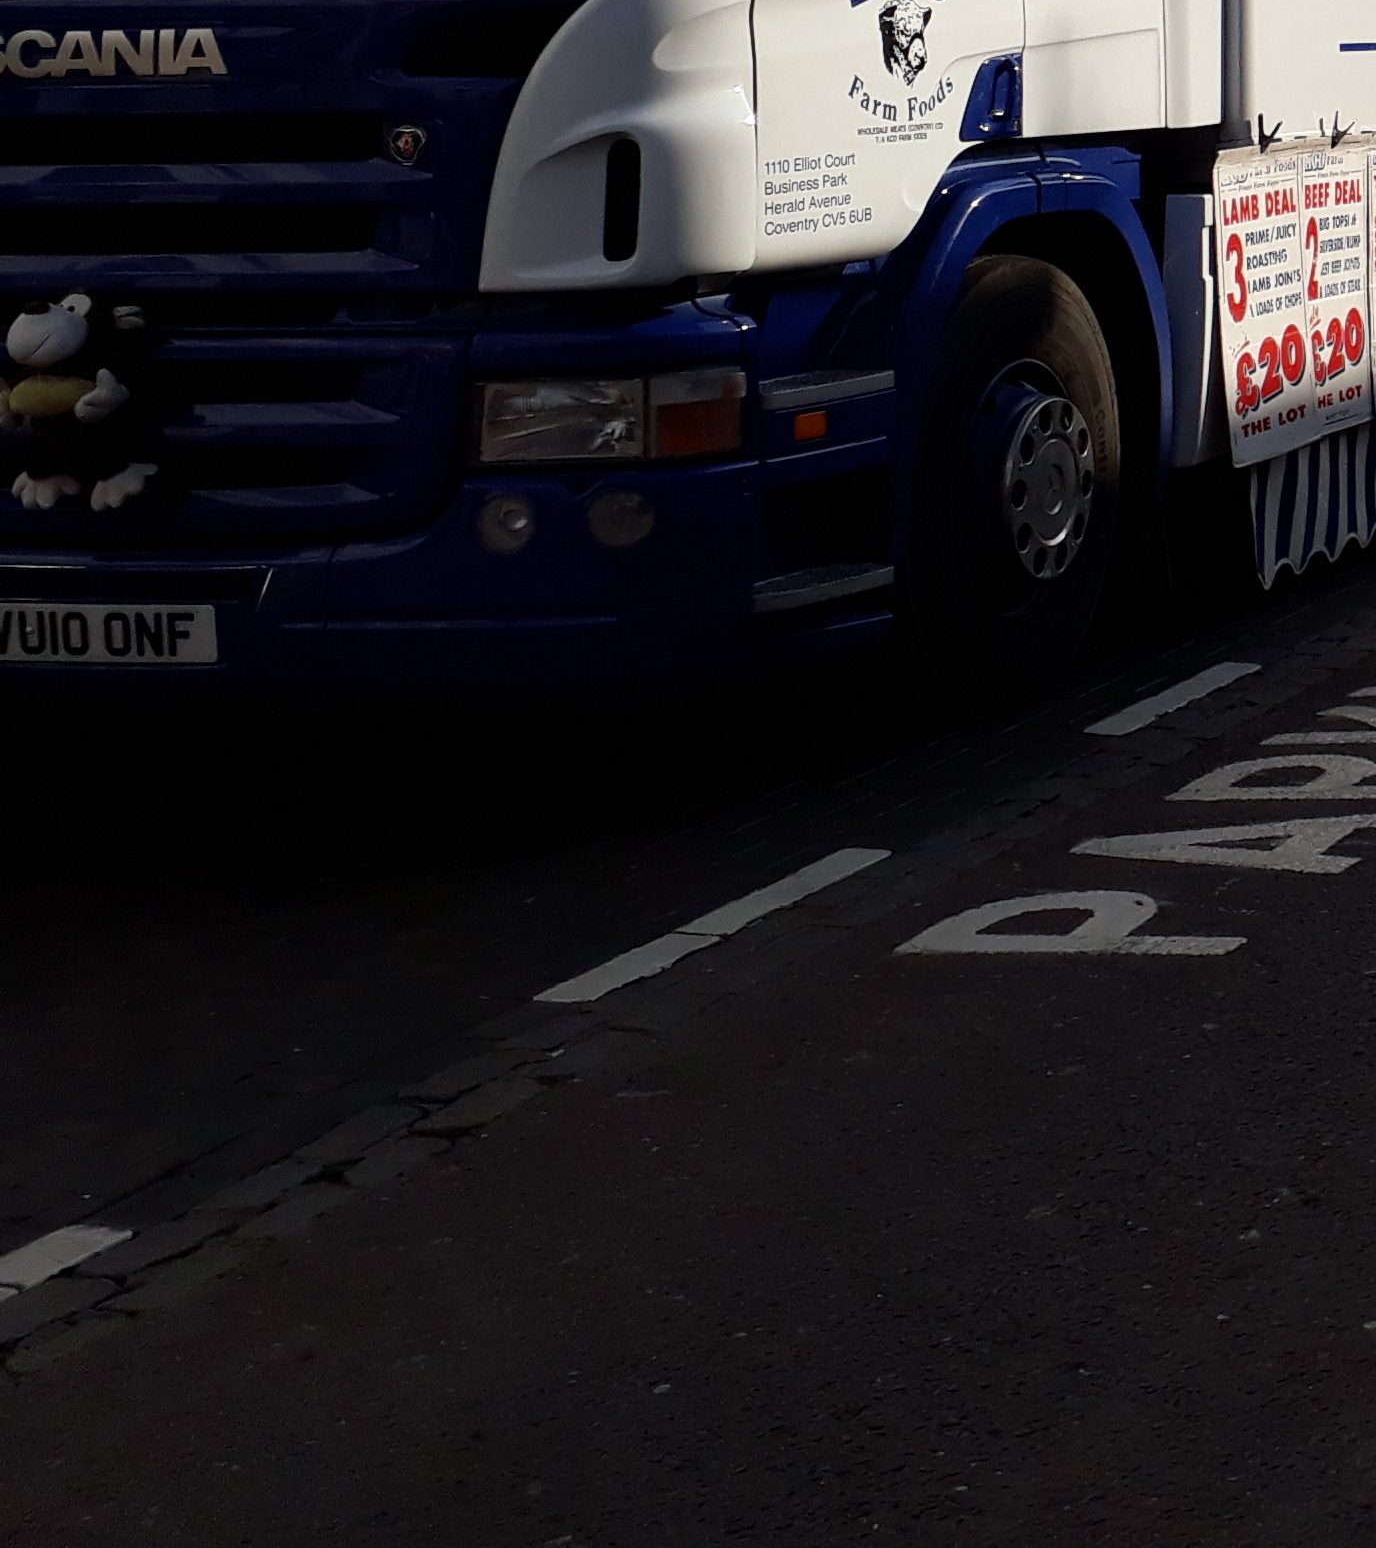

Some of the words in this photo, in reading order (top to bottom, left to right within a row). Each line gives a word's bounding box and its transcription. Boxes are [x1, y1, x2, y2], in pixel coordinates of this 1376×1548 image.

[0, 28, 228, 78] CANIA
[848, 75, 898, 122] Farm
[907, 76, 954, 121] Foods
[764, 159, 790, 176] 1110
[794, 157, 822, 172] Elliot
[824, 153, 856, 168] Court
[764, 178, 819, 196] Business
[822, 172, 848, 188] Park
[1304, 183, 1330, 210] BEEF
[1335, 179, 1362, 206] DEAL
[764, 197, 805, 216] Herald
[808, 194, 851, 209] Avenue
[1223, 194, 1260, 226] LAMB
[1265, 188, 1296, 218] DEAL
[764, 216, 819, 236] Coventry
[822, 211, 846, 228] CV5
[849, 207, 872, 224] 6UB
[1246, 249, 1288, 270] ROASTING
[1305, 216, 1319, 301] 2
[1226, 233, 1247, 323] 3
[1274, 269, 1301, 286] JOINTS
[1275, 298, 1283, 312] OF
[1311, 307, 1365, 387] £20
[1235, 324, 1306, 419] £20
[1318, 393, 1334, 408] HE
[1339, 385, 1363, 403] LOT
[1241, 417, 1271, 438] THE
[1278, 405, 1306, 425] LOT
[104, 612, 194, 656] ONF
